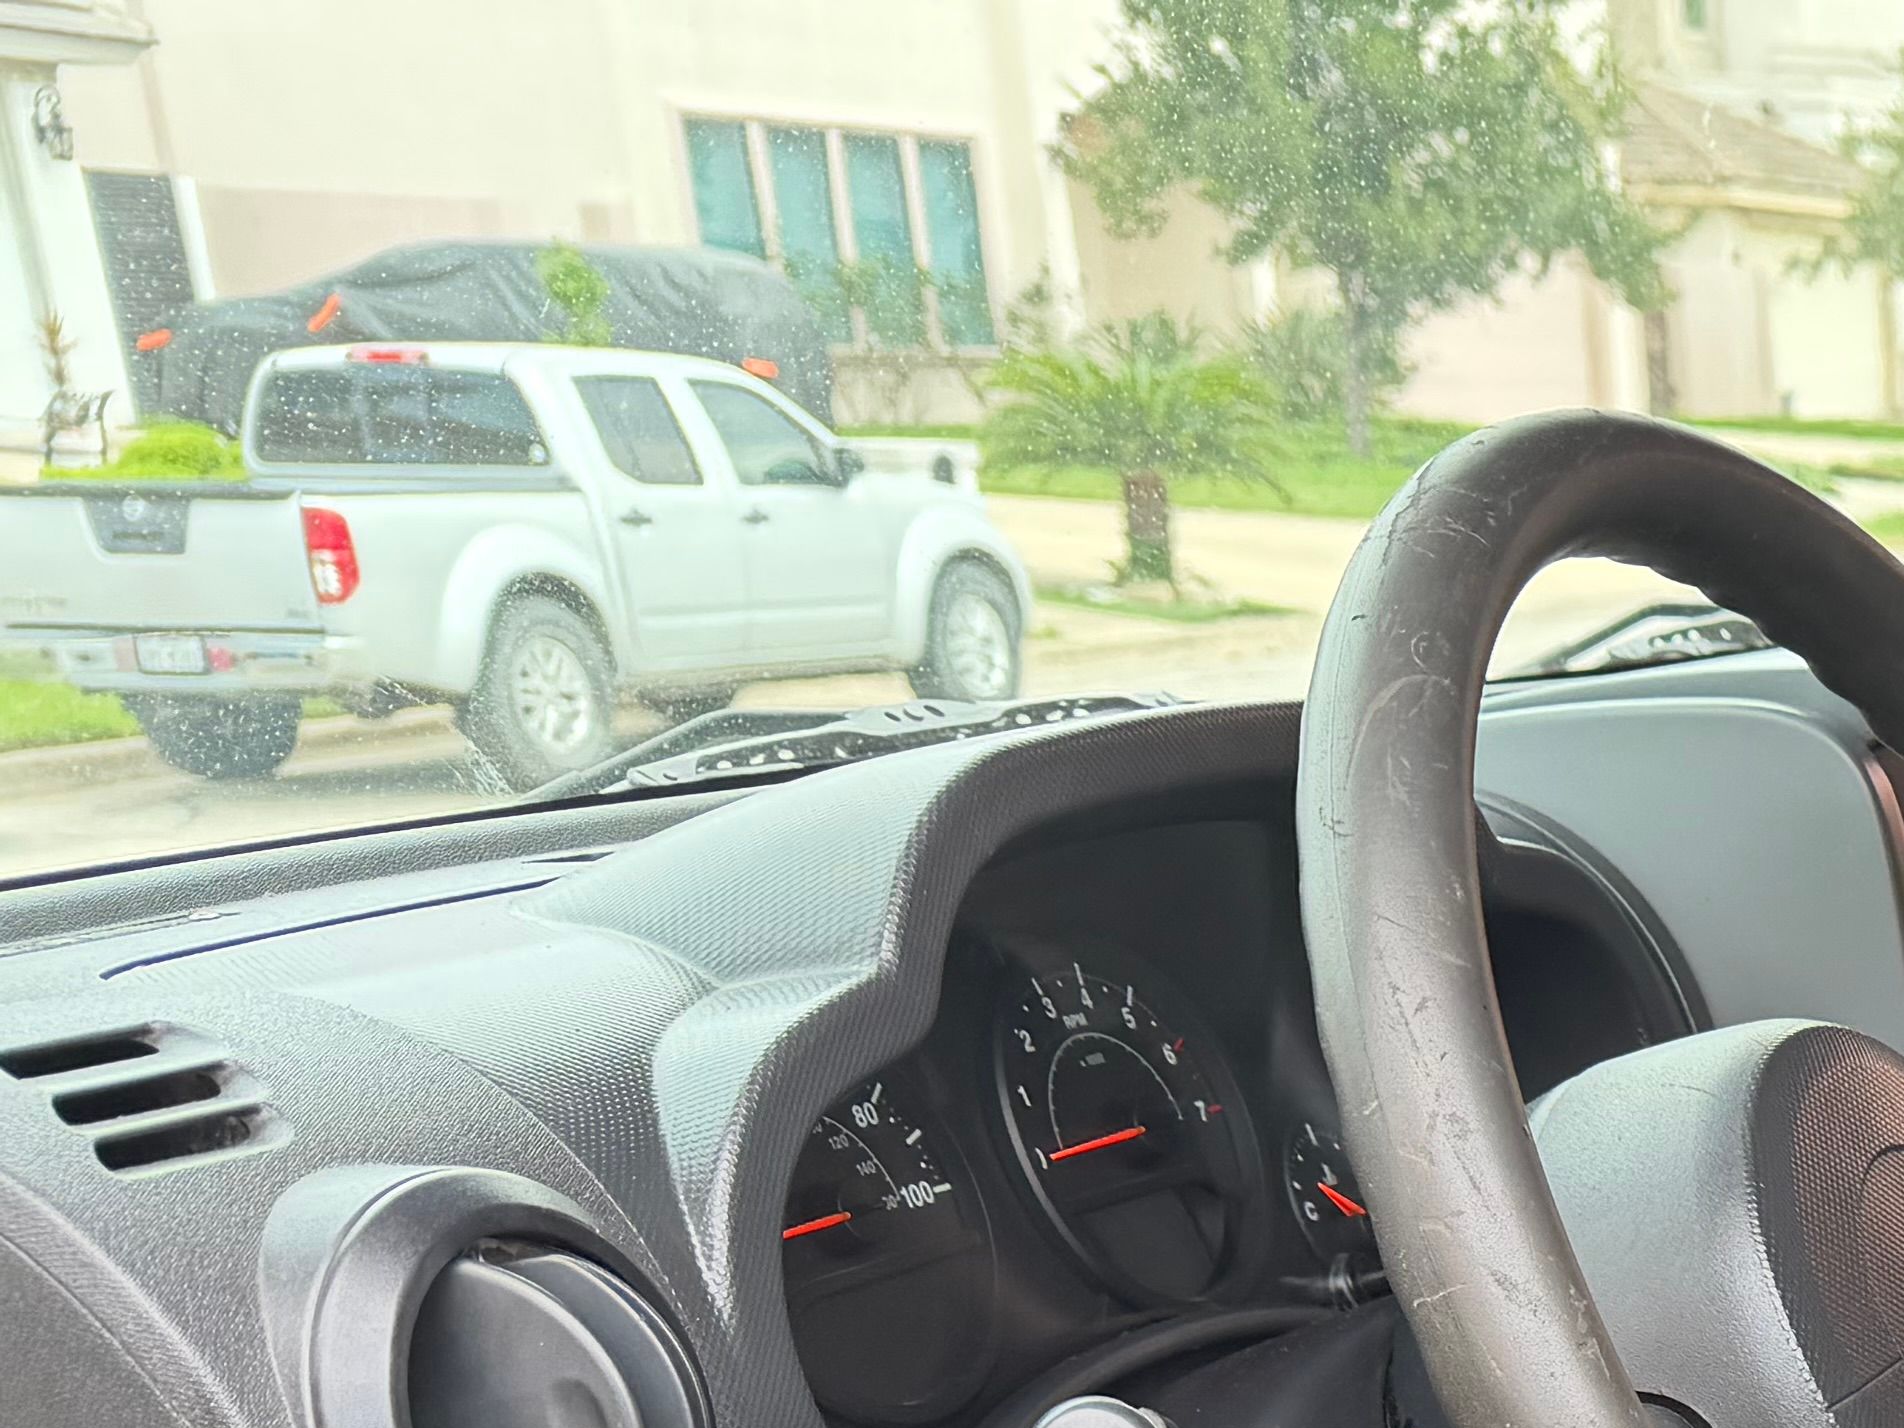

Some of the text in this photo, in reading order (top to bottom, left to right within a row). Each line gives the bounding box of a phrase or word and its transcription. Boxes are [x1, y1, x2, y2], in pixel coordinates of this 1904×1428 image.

[1041, 996, 1057, 1019] 3
[1080, 987, 1094, 1009] 4
[1121, 1007, 1137, 1030] 5
[1019, 1029, 1036, 1053] 2
[1161, 1042, 1178, 1065] 6
[1017, 1085, 1032, 1107] 1
[851, 1102, 880, 1129] 80
[1193, 1100, 1208, 1122] 7
[828, 1134, 849, 1150] 120
[855, 1159, 877, 1177] 140
[900, 1180, 935, 1209] 100
[1304, 1200, 1320, 1222] C
